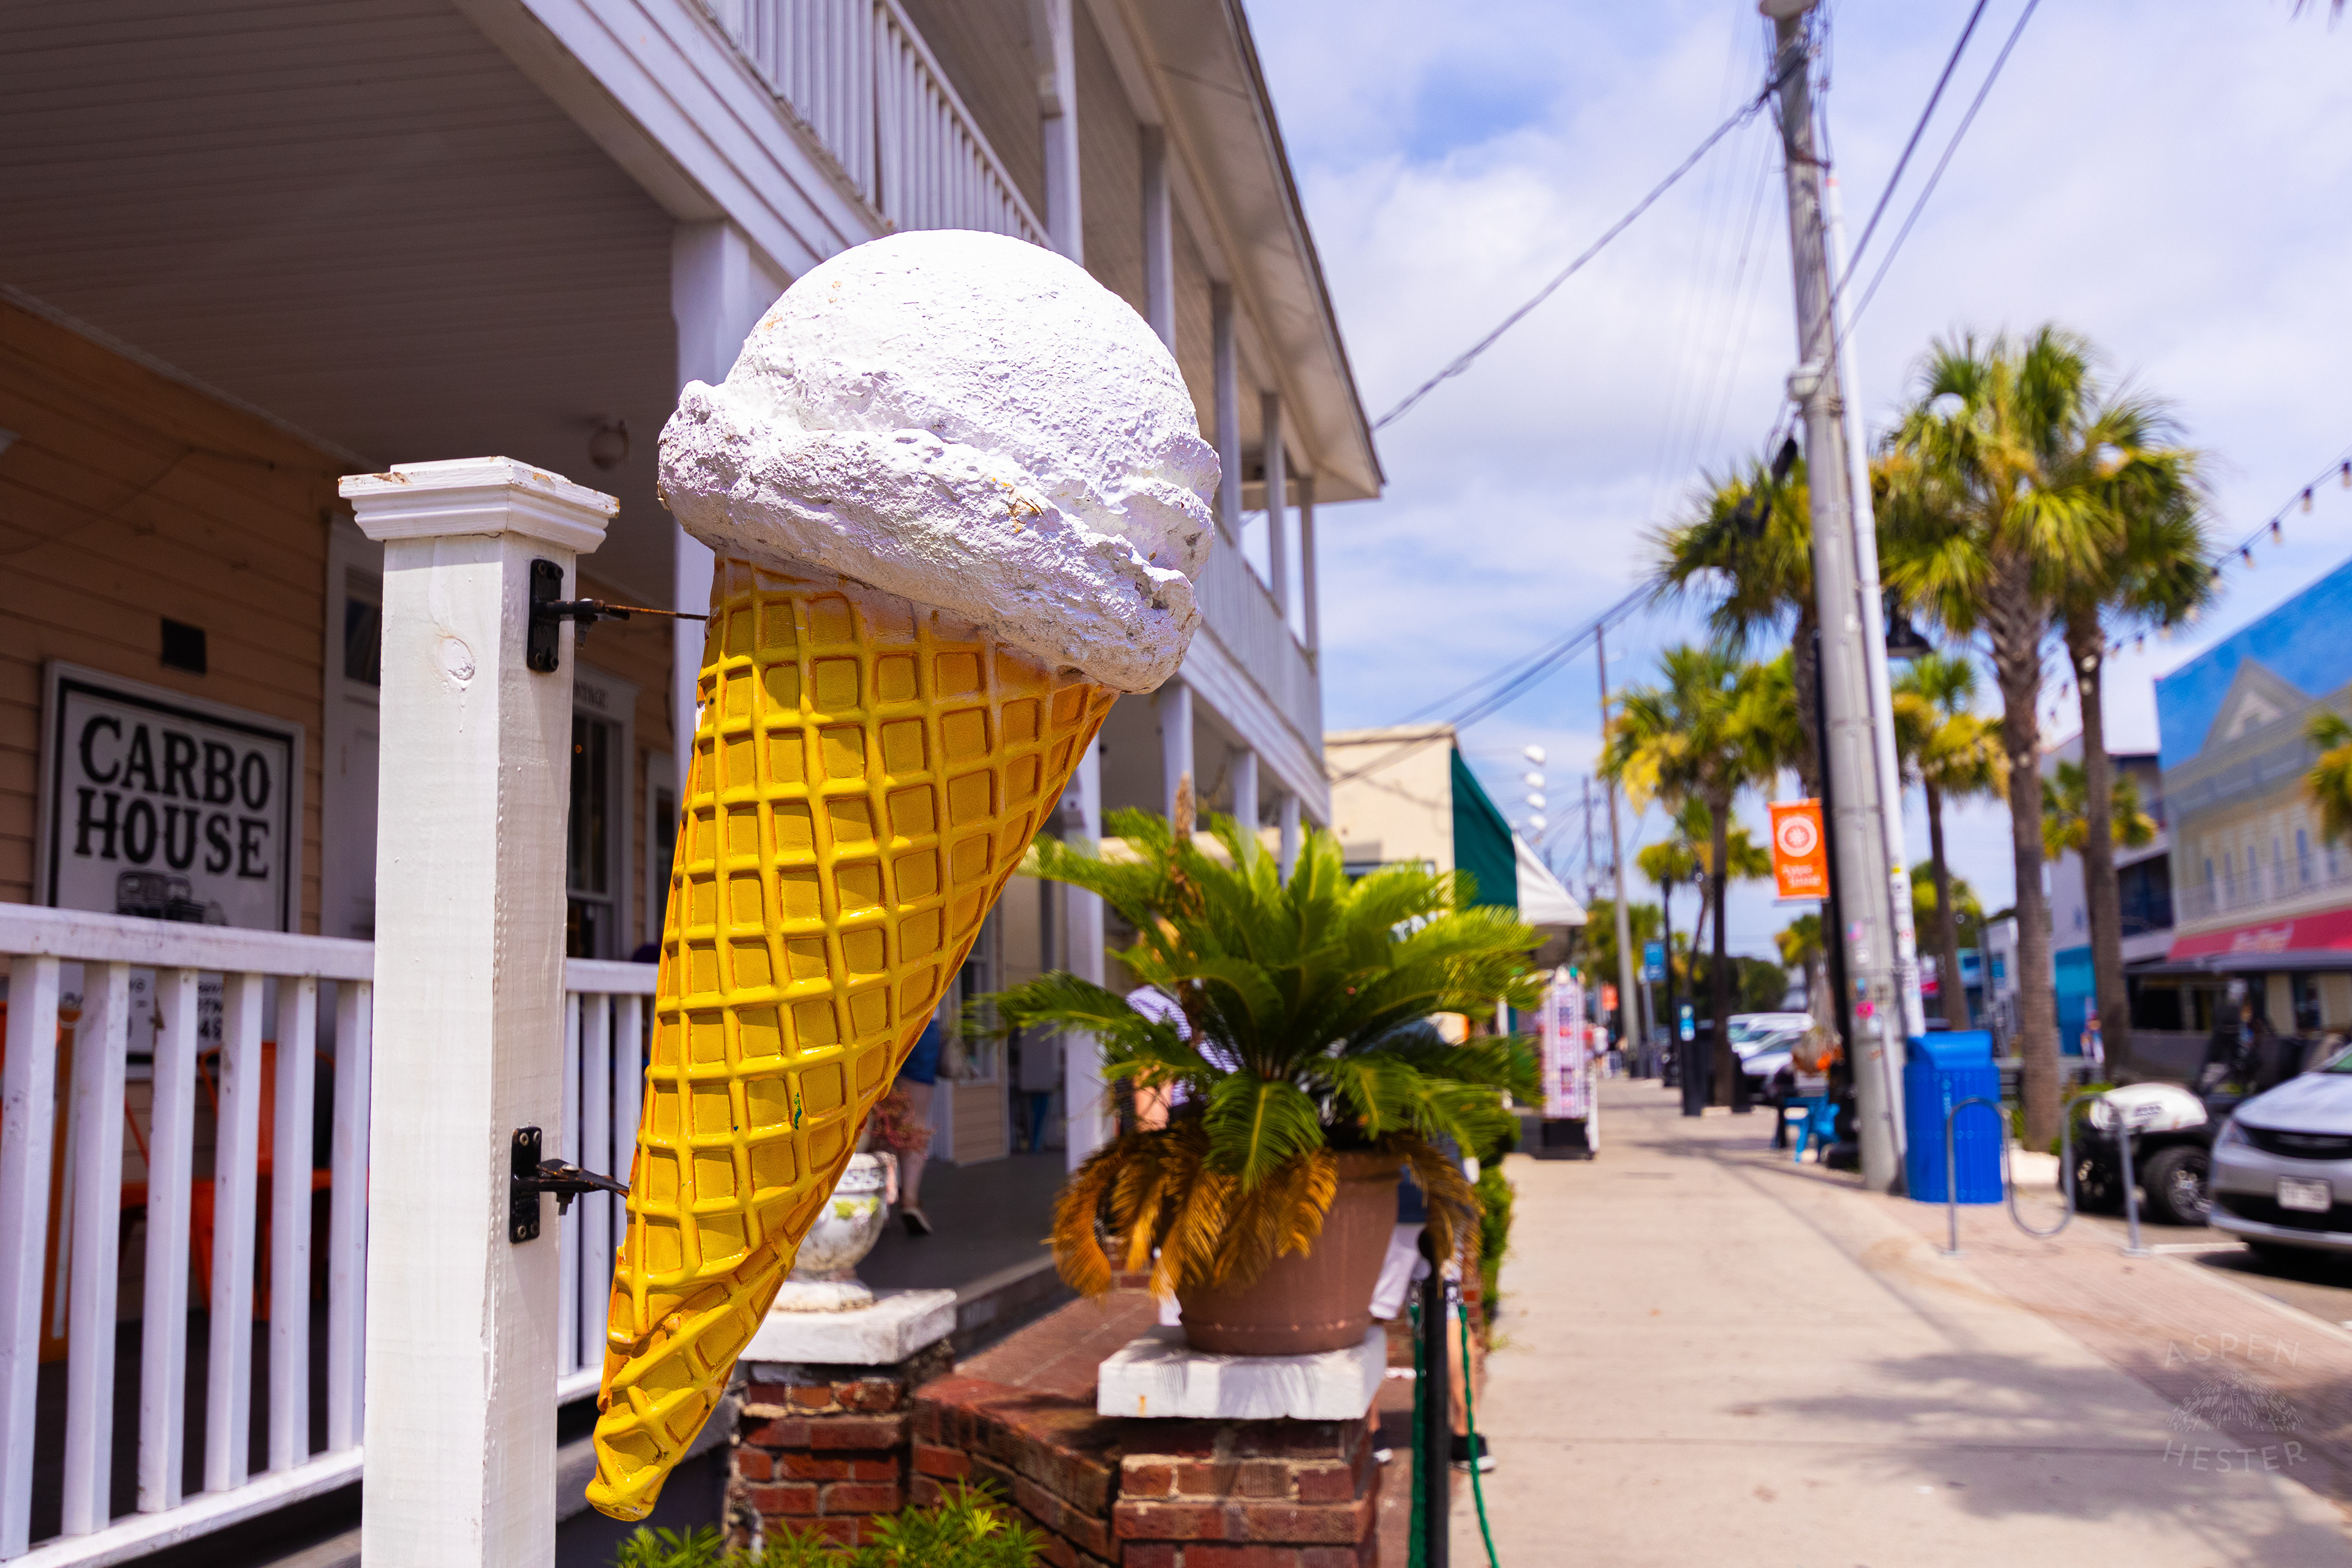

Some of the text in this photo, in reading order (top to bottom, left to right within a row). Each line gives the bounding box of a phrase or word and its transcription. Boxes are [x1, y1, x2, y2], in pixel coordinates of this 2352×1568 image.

[573, 680, 607, 708] NTAGE
[80, 714, 271, 812] CARBO
[74, 786, 270, 880] HOUSE
